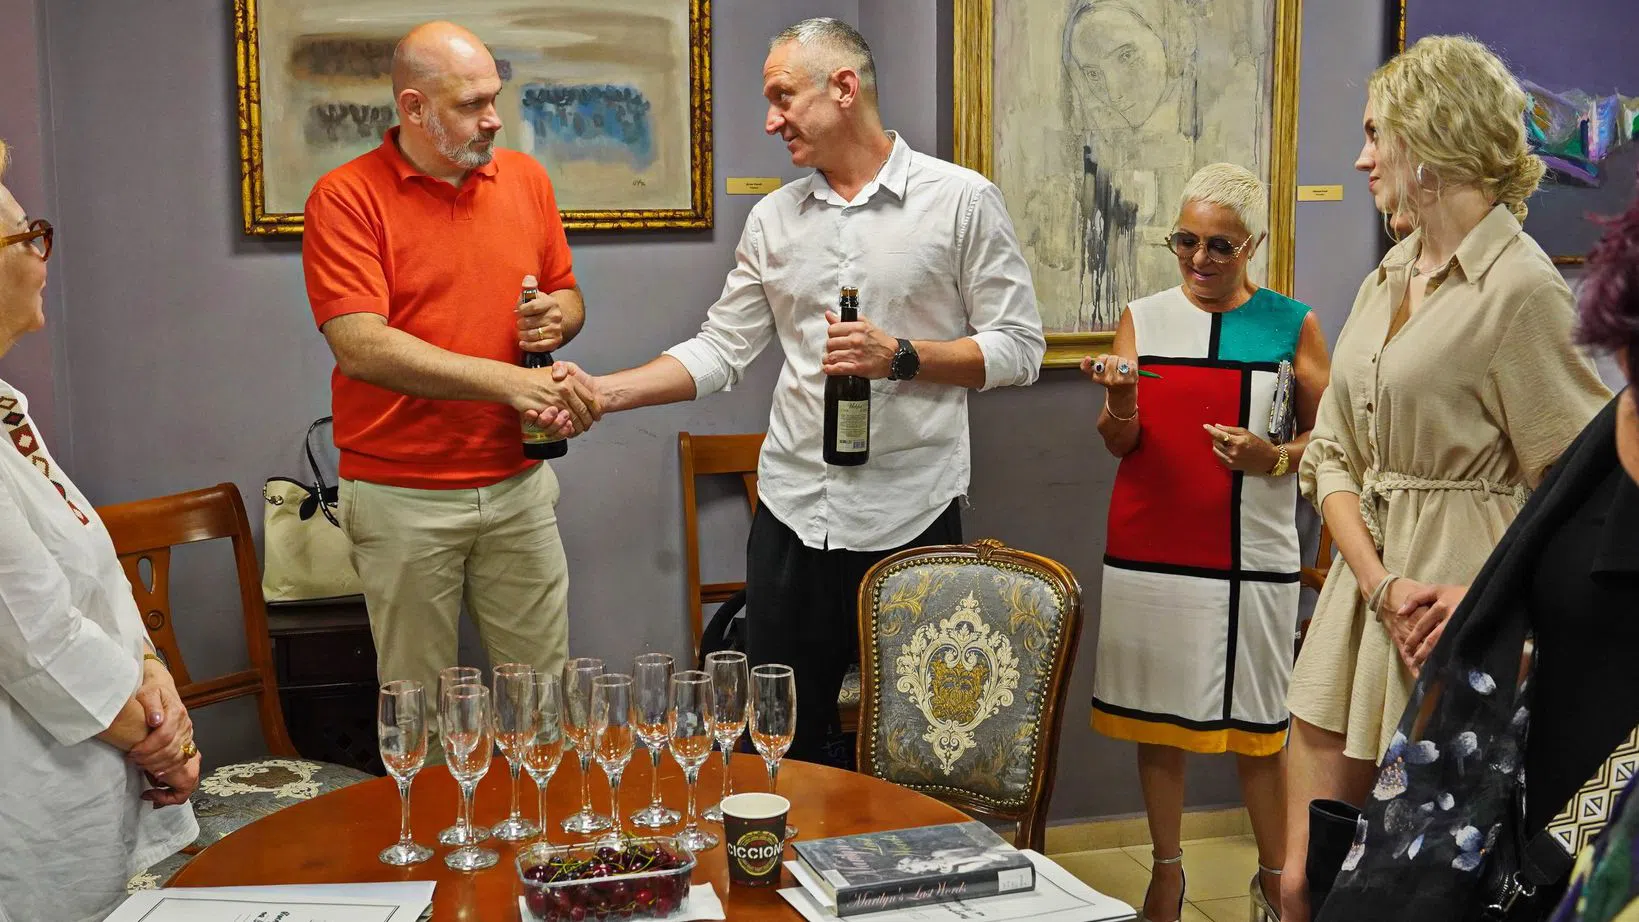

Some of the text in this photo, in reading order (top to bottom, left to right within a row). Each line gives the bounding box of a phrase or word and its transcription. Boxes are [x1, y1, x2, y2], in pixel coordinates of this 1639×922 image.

[846, 880, 967, 909] Marilyn's Last Words
